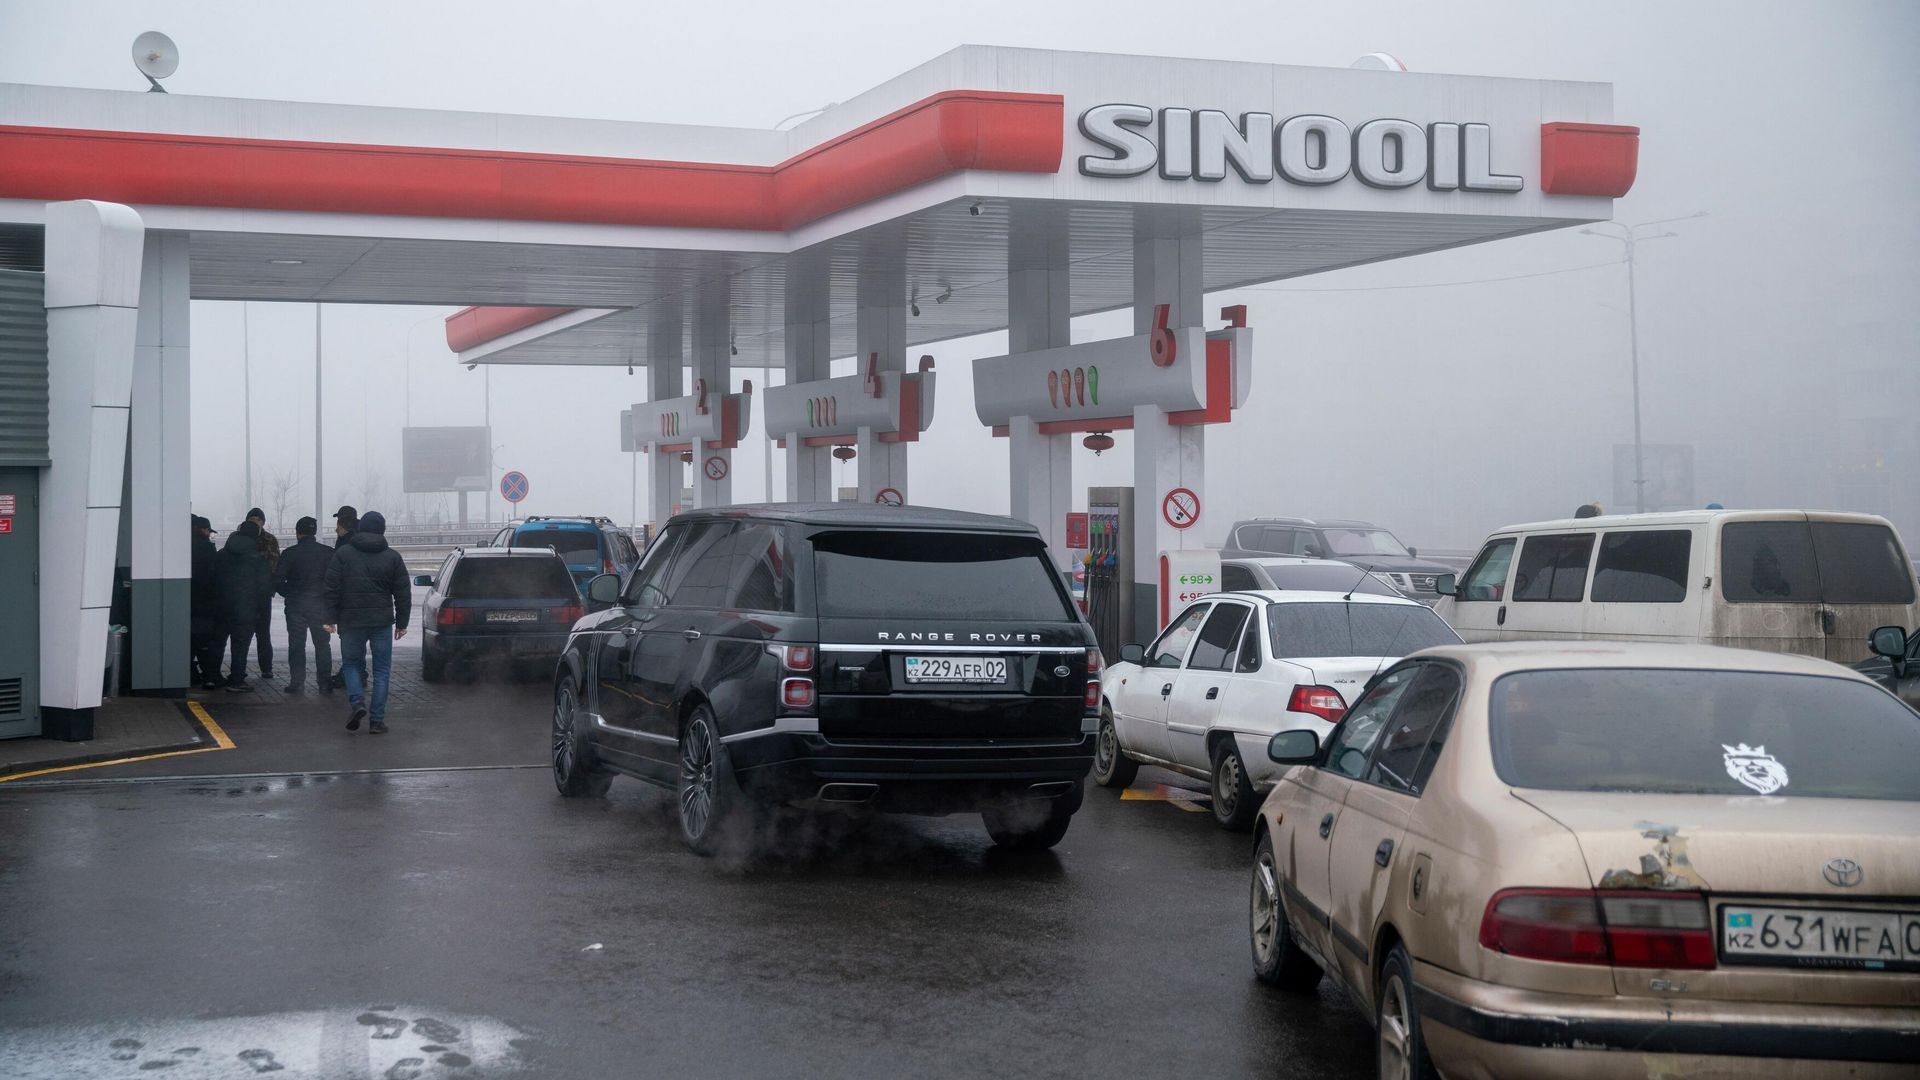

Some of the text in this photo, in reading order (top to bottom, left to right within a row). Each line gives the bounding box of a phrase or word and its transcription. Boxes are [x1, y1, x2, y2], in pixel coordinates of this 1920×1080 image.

[1078, 103, 1523, 192] SINOOIL
[1150, 304, 1176, 368] 6
[1190, 575, 1204, 584] 98
[878, 632, 1041, 642] RANGE ROVER
[908, 669, 919, 677] KZ
[1728, 933, 1755, 948] KZ
